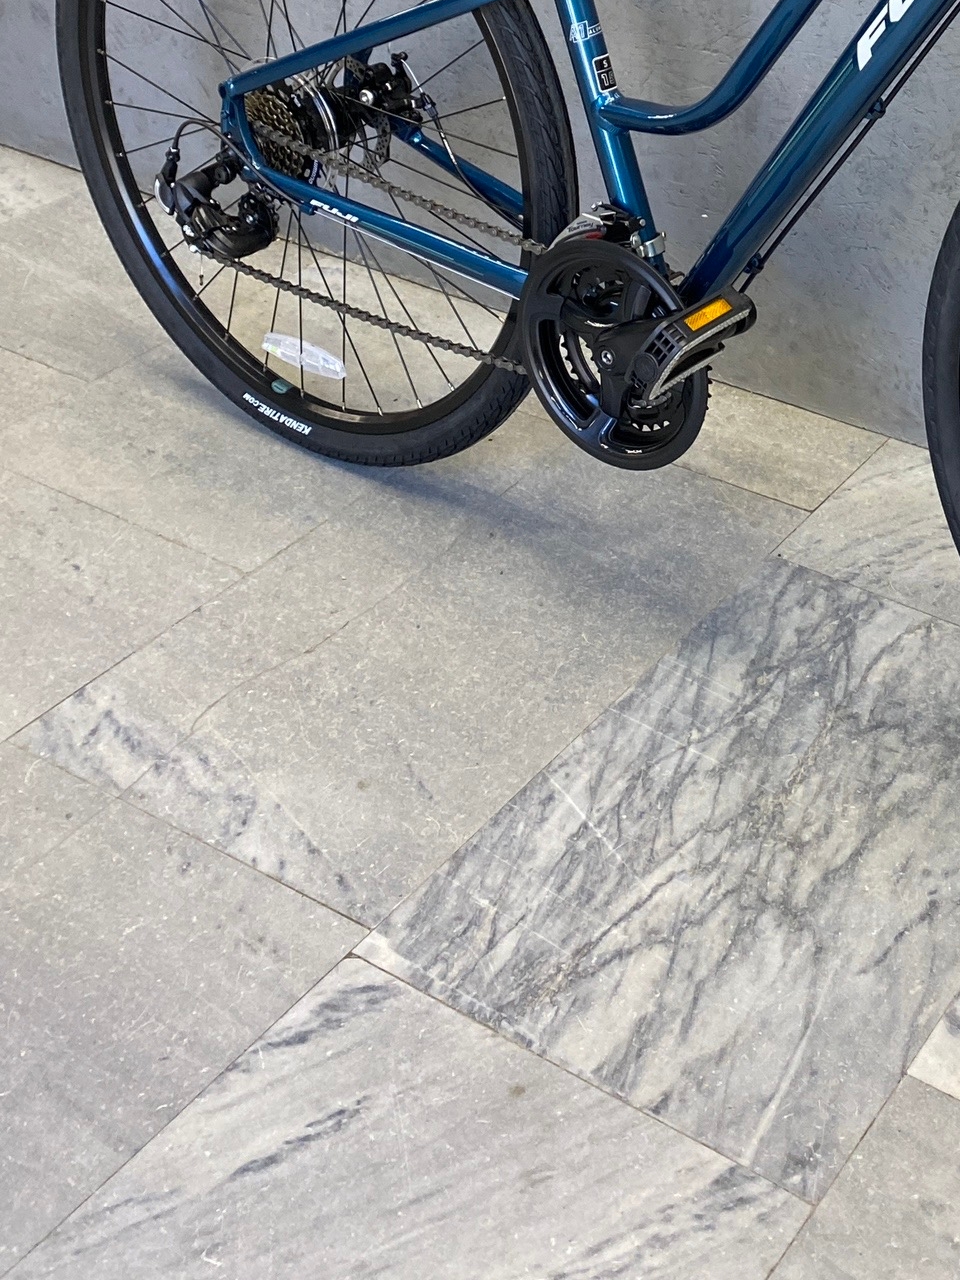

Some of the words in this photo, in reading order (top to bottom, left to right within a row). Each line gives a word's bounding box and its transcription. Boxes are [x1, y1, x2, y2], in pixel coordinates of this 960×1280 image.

[602, 59, 609, 68] S
[310, 199, 359, 223] FUJI
[243, 392, 313, 435] KENDATIRE.COM
